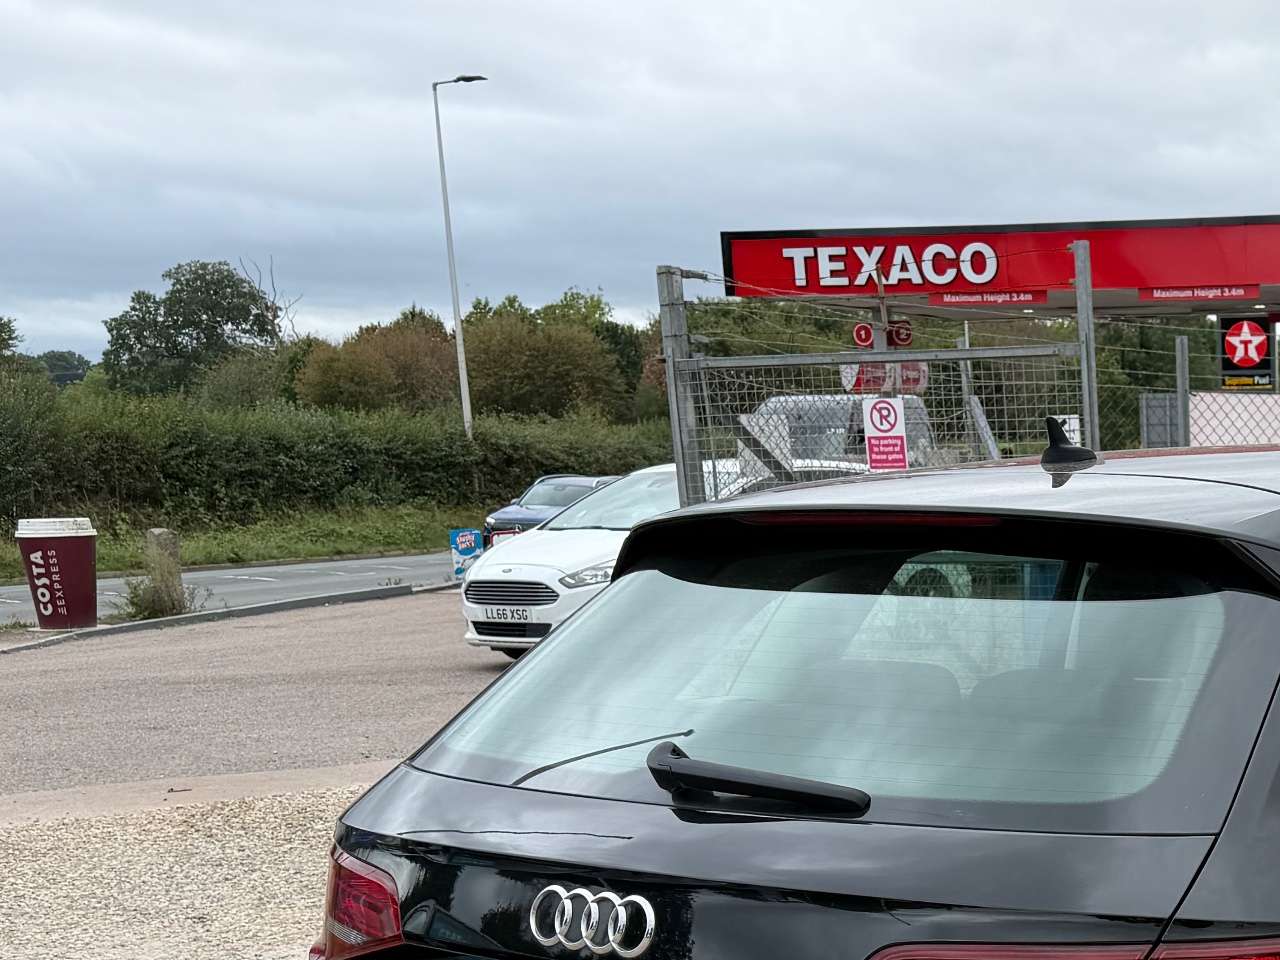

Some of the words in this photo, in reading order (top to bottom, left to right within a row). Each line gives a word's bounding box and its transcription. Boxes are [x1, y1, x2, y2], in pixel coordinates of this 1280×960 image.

[782, 242, 998, 287] TEXACO
[943, 294, 981, 303] Maximum
[983, 293, 1010, 304] Height
[1011, 293, 1033, 302] 3.4m
[1152, 289, 1192, 298] Maximum
[1193, 288, 1222, 299] Height
[1223, 287, 1245, 297] 3.4m
[888, 453, 903, 461] gates
[30, 550, 53, 616] COSTA
[48, 550, 66, 606] EXPRESS
[485, 607, 508, 620] LL66
[510, 608, 528, 621] XSG
